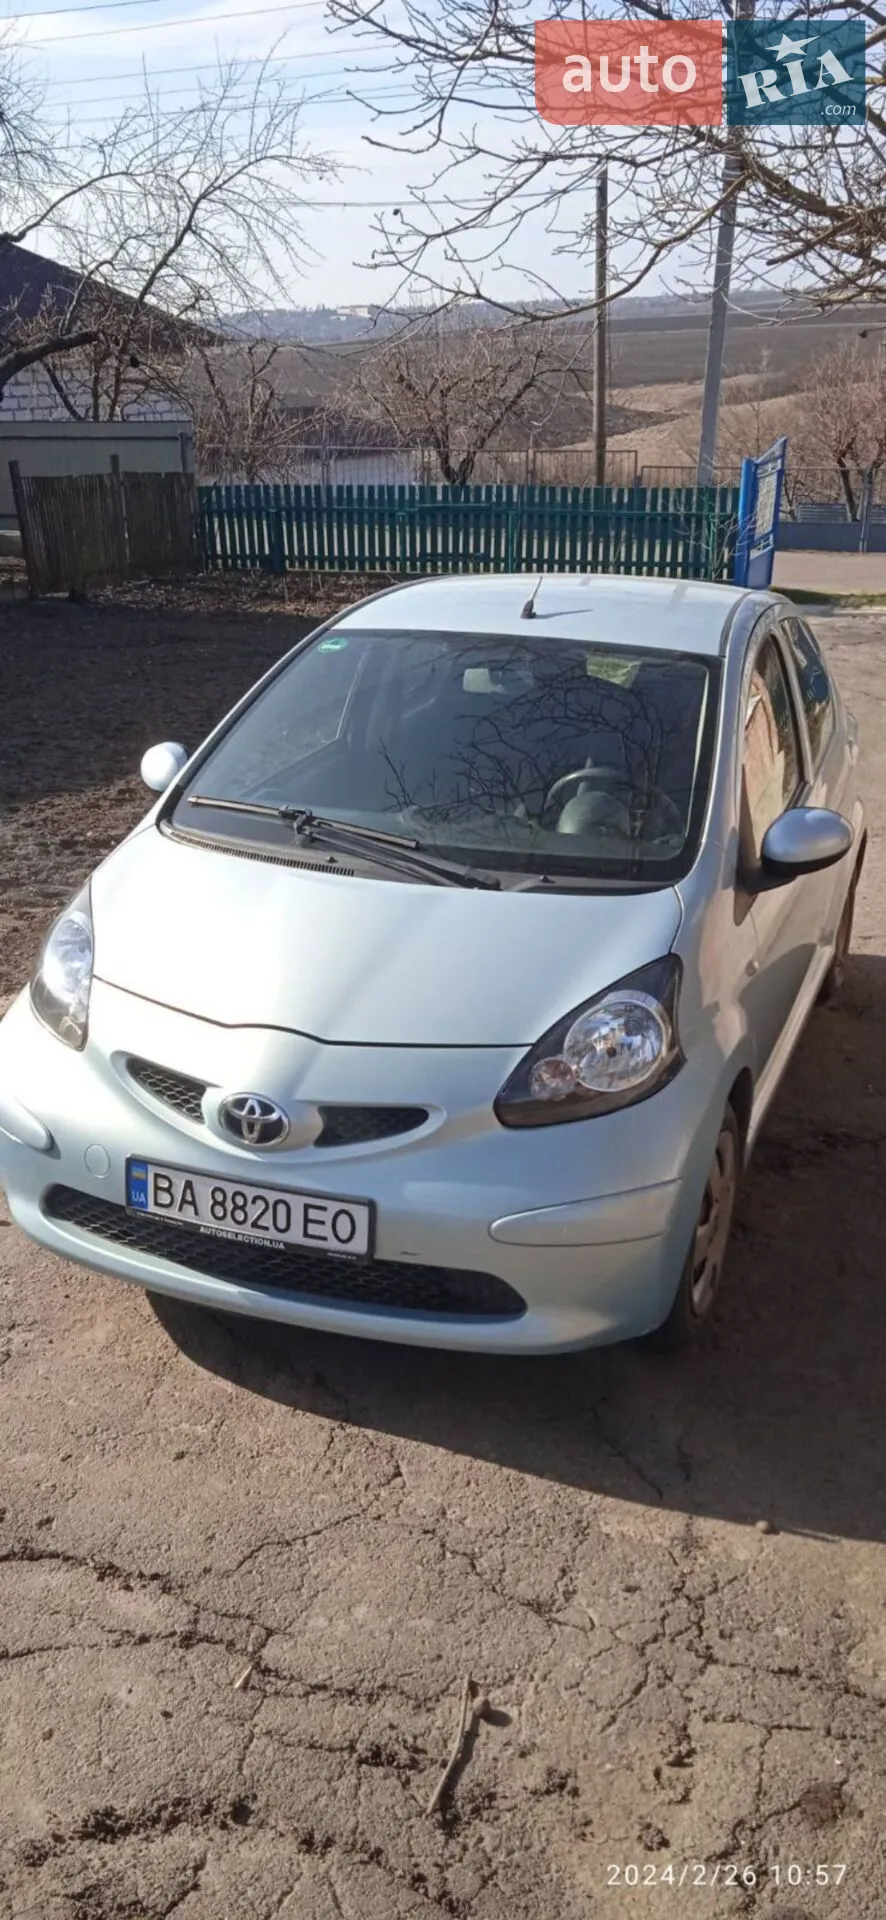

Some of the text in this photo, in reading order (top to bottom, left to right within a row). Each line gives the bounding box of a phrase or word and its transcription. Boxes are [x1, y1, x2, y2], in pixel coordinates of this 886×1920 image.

[132, 1191, 146, 1204] UA
[153, 1172, 356, 1244] BA 8820 EO
[200, 1225, 285, 1250] AUTOSELECTION.UA
